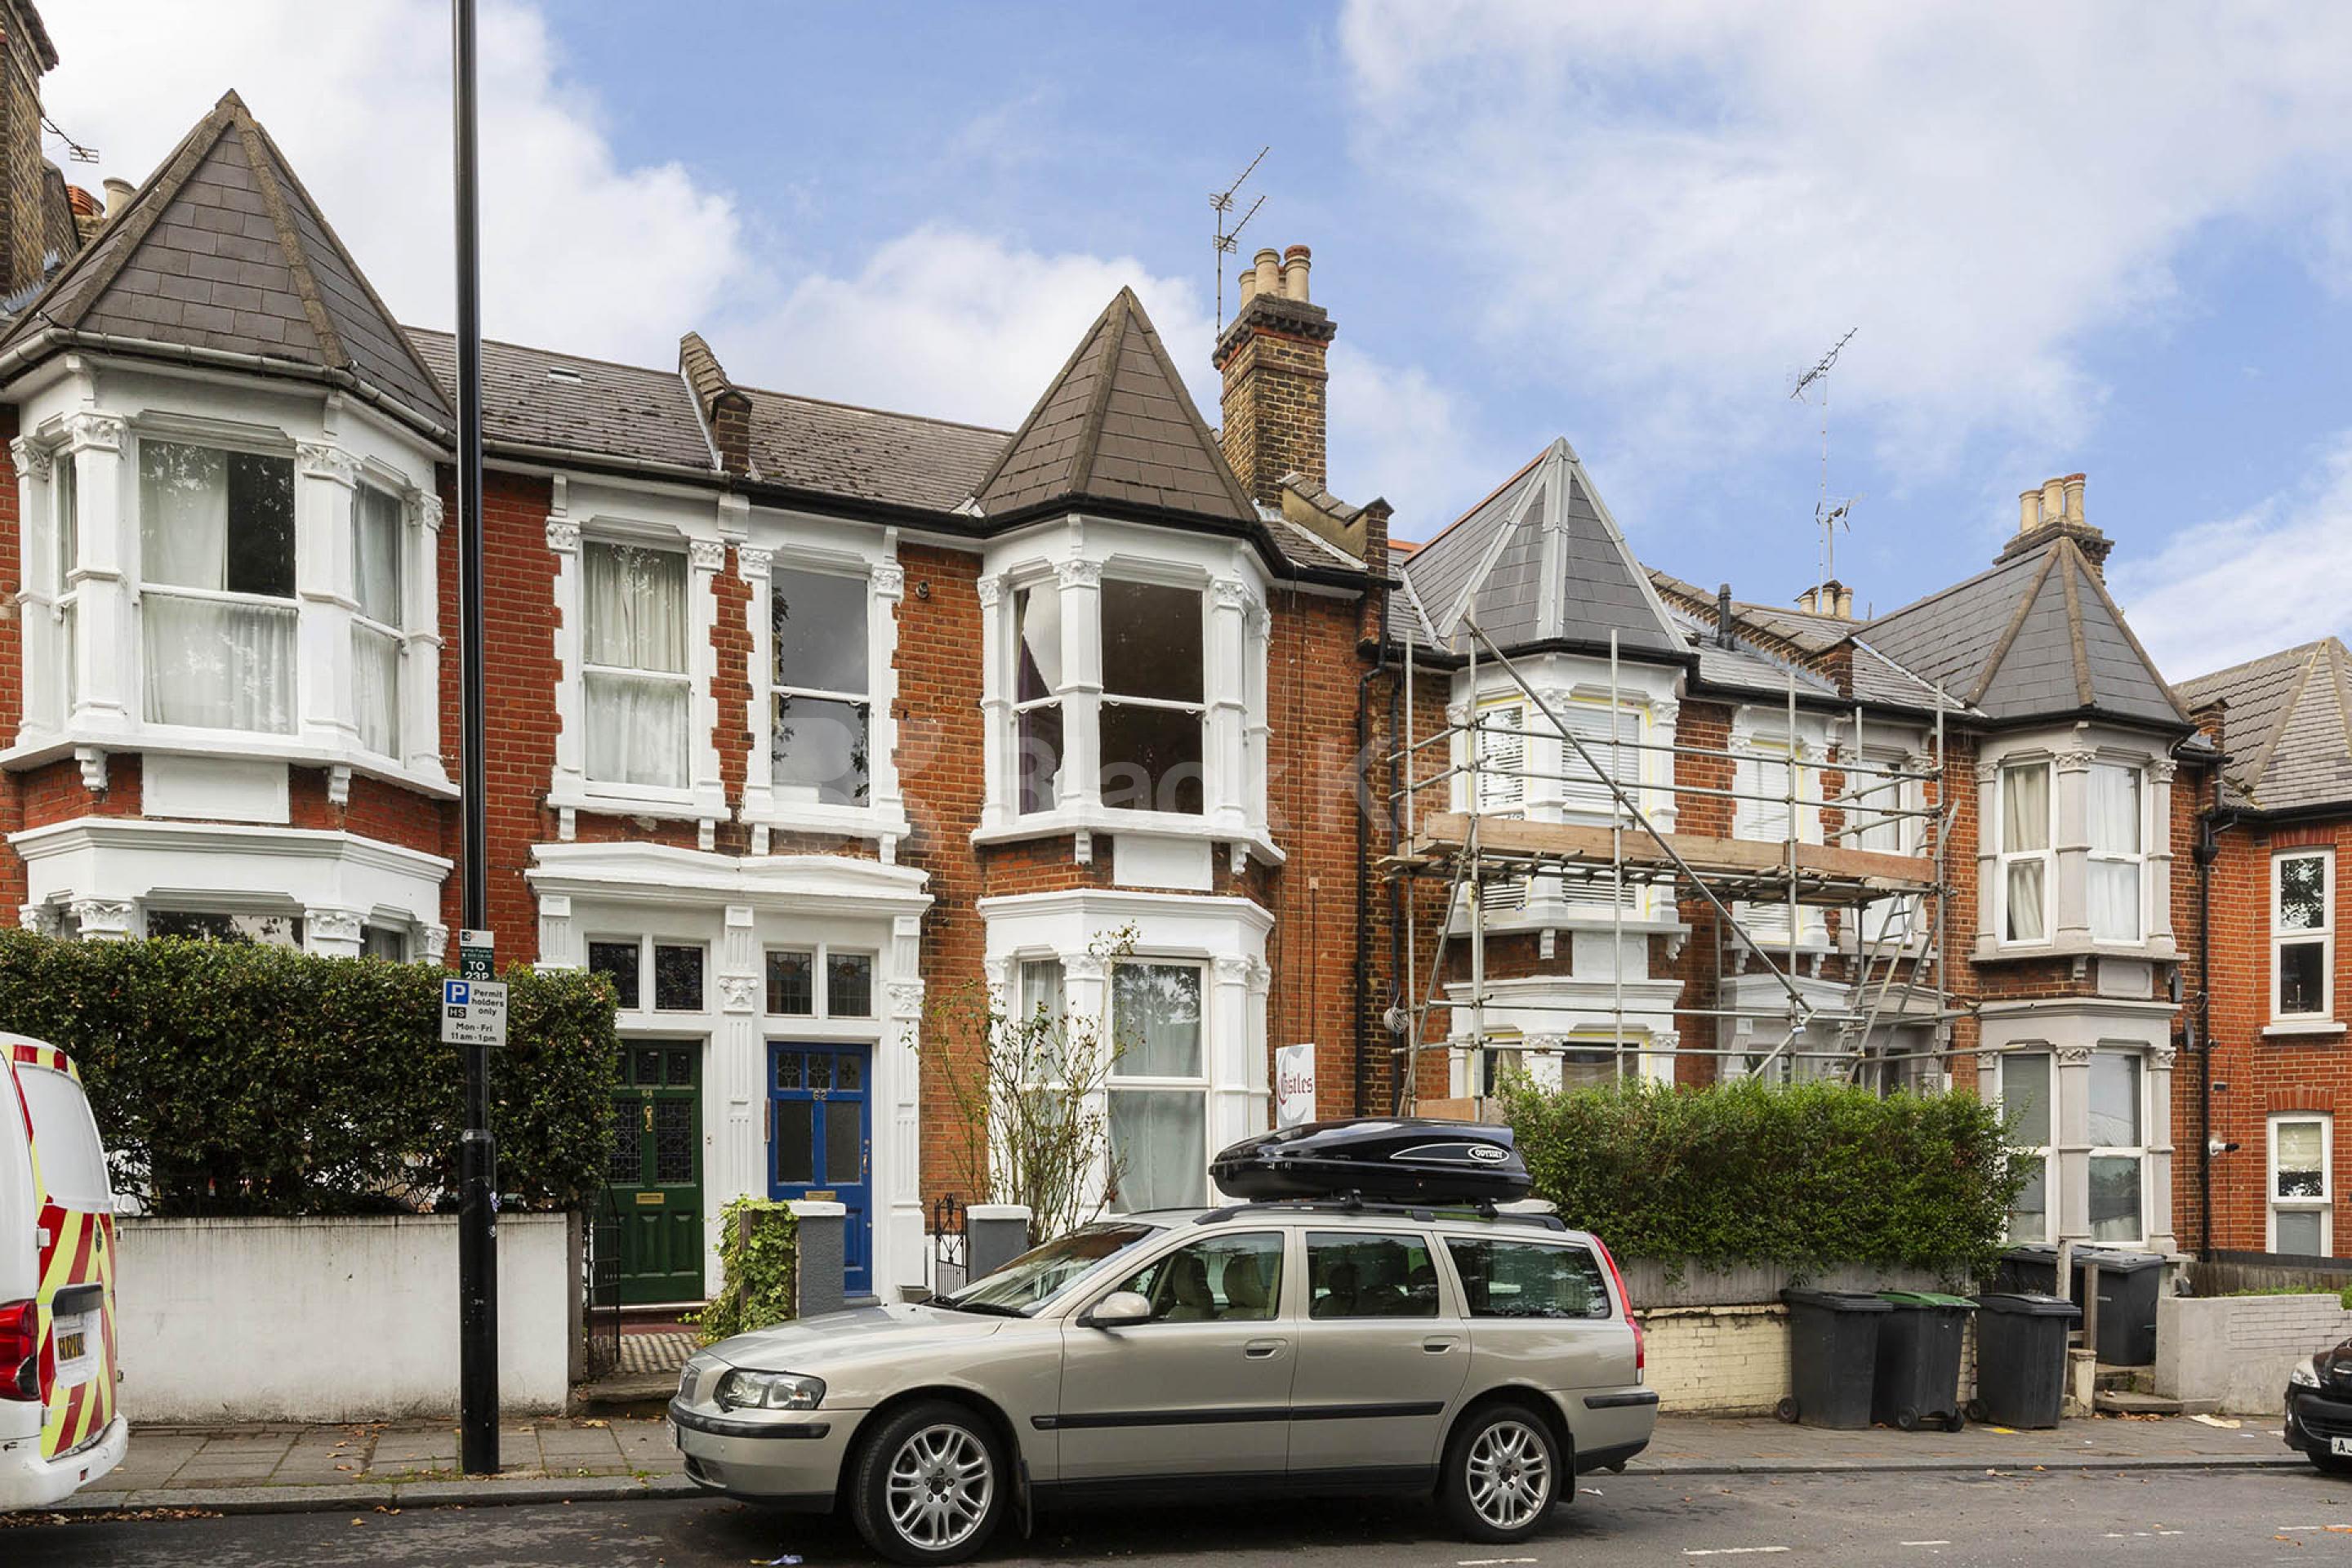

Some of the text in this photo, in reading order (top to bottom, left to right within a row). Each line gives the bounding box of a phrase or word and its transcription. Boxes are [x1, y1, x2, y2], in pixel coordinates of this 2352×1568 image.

[468, 960, 486, 971] TO
[451, 984, 466, 1002] P
[474, 989, 503, 998] Permit
[471, 997, 504, 1007] holders
[478, 1007, 497, 1017] only
